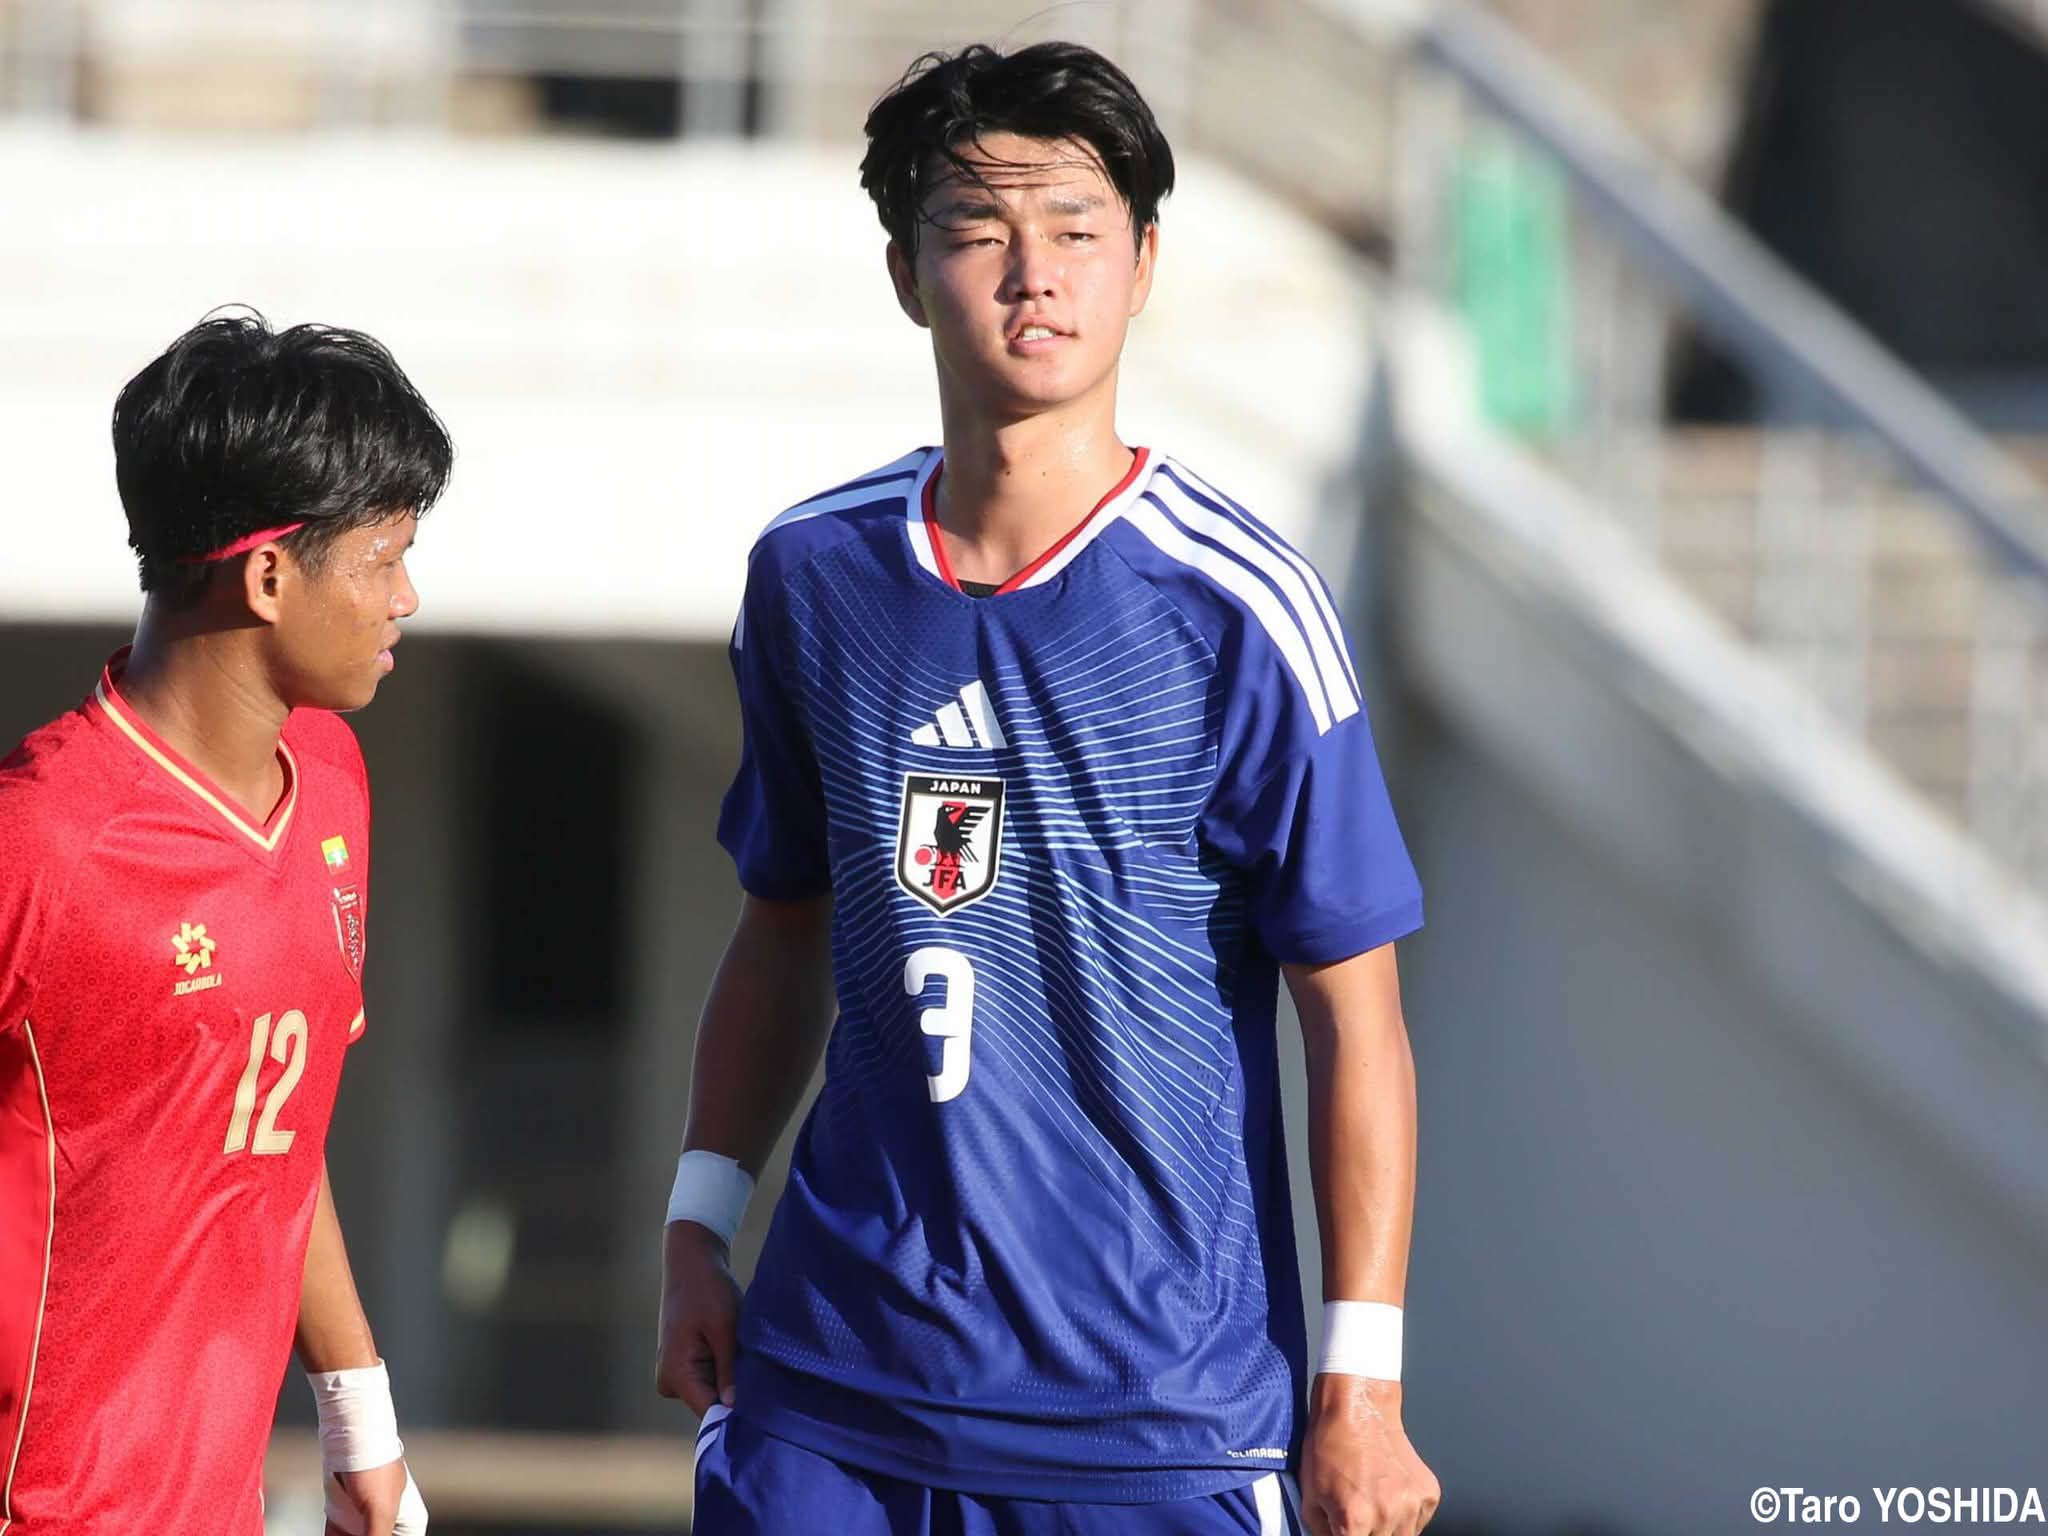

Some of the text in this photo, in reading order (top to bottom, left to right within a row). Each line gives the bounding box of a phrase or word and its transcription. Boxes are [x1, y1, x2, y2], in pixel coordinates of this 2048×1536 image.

[929, 780, 982, 795] JAPAN
[922, 868, 967, 891] JFA
[904, 946, 976, 1104] 3
[223, 1008, 309, 1155] 12
